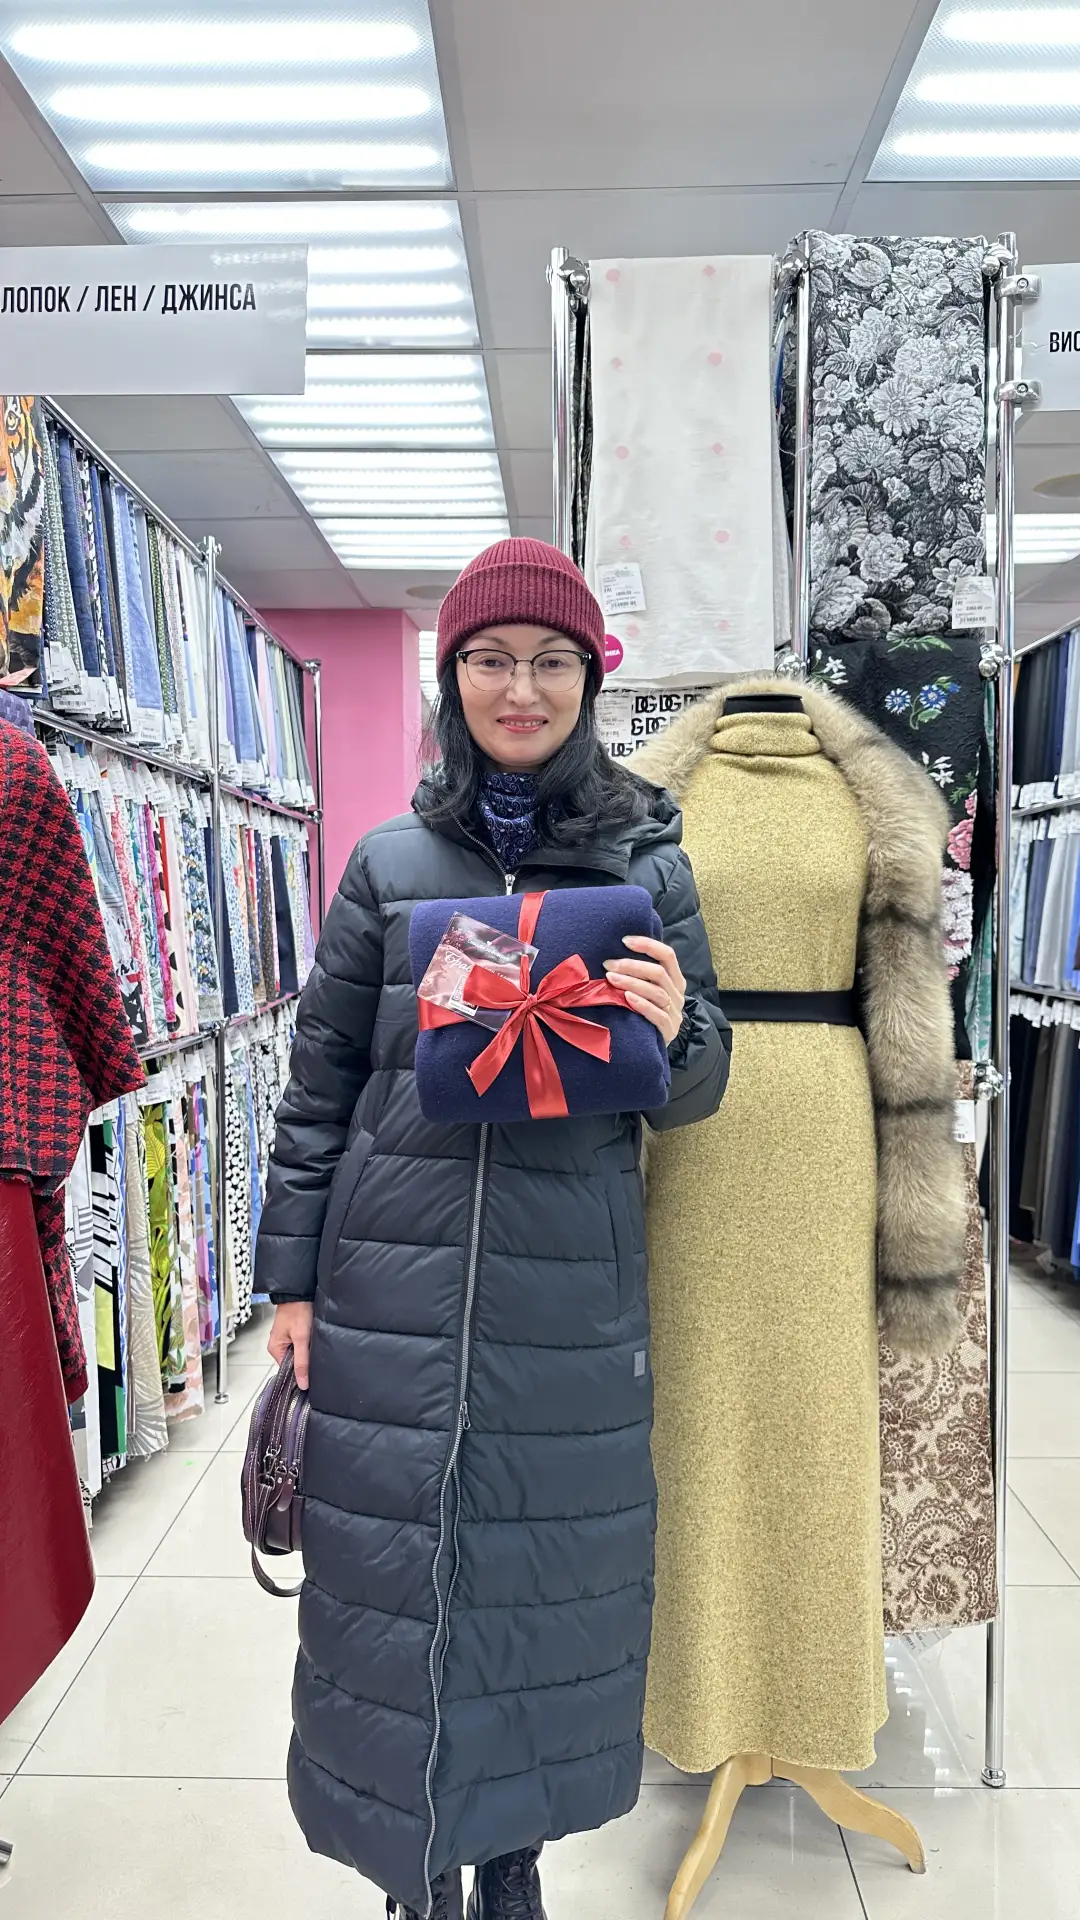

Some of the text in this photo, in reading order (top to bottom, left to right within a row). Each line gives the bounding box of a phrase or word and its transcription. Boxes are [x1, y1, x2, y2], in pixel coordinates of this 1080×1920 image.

[1, 286, 71, 313] ЛОПОК
[94, 285, 137, 312] ЛЕН
[161, 283, 257, 315] ДЖИНСА
